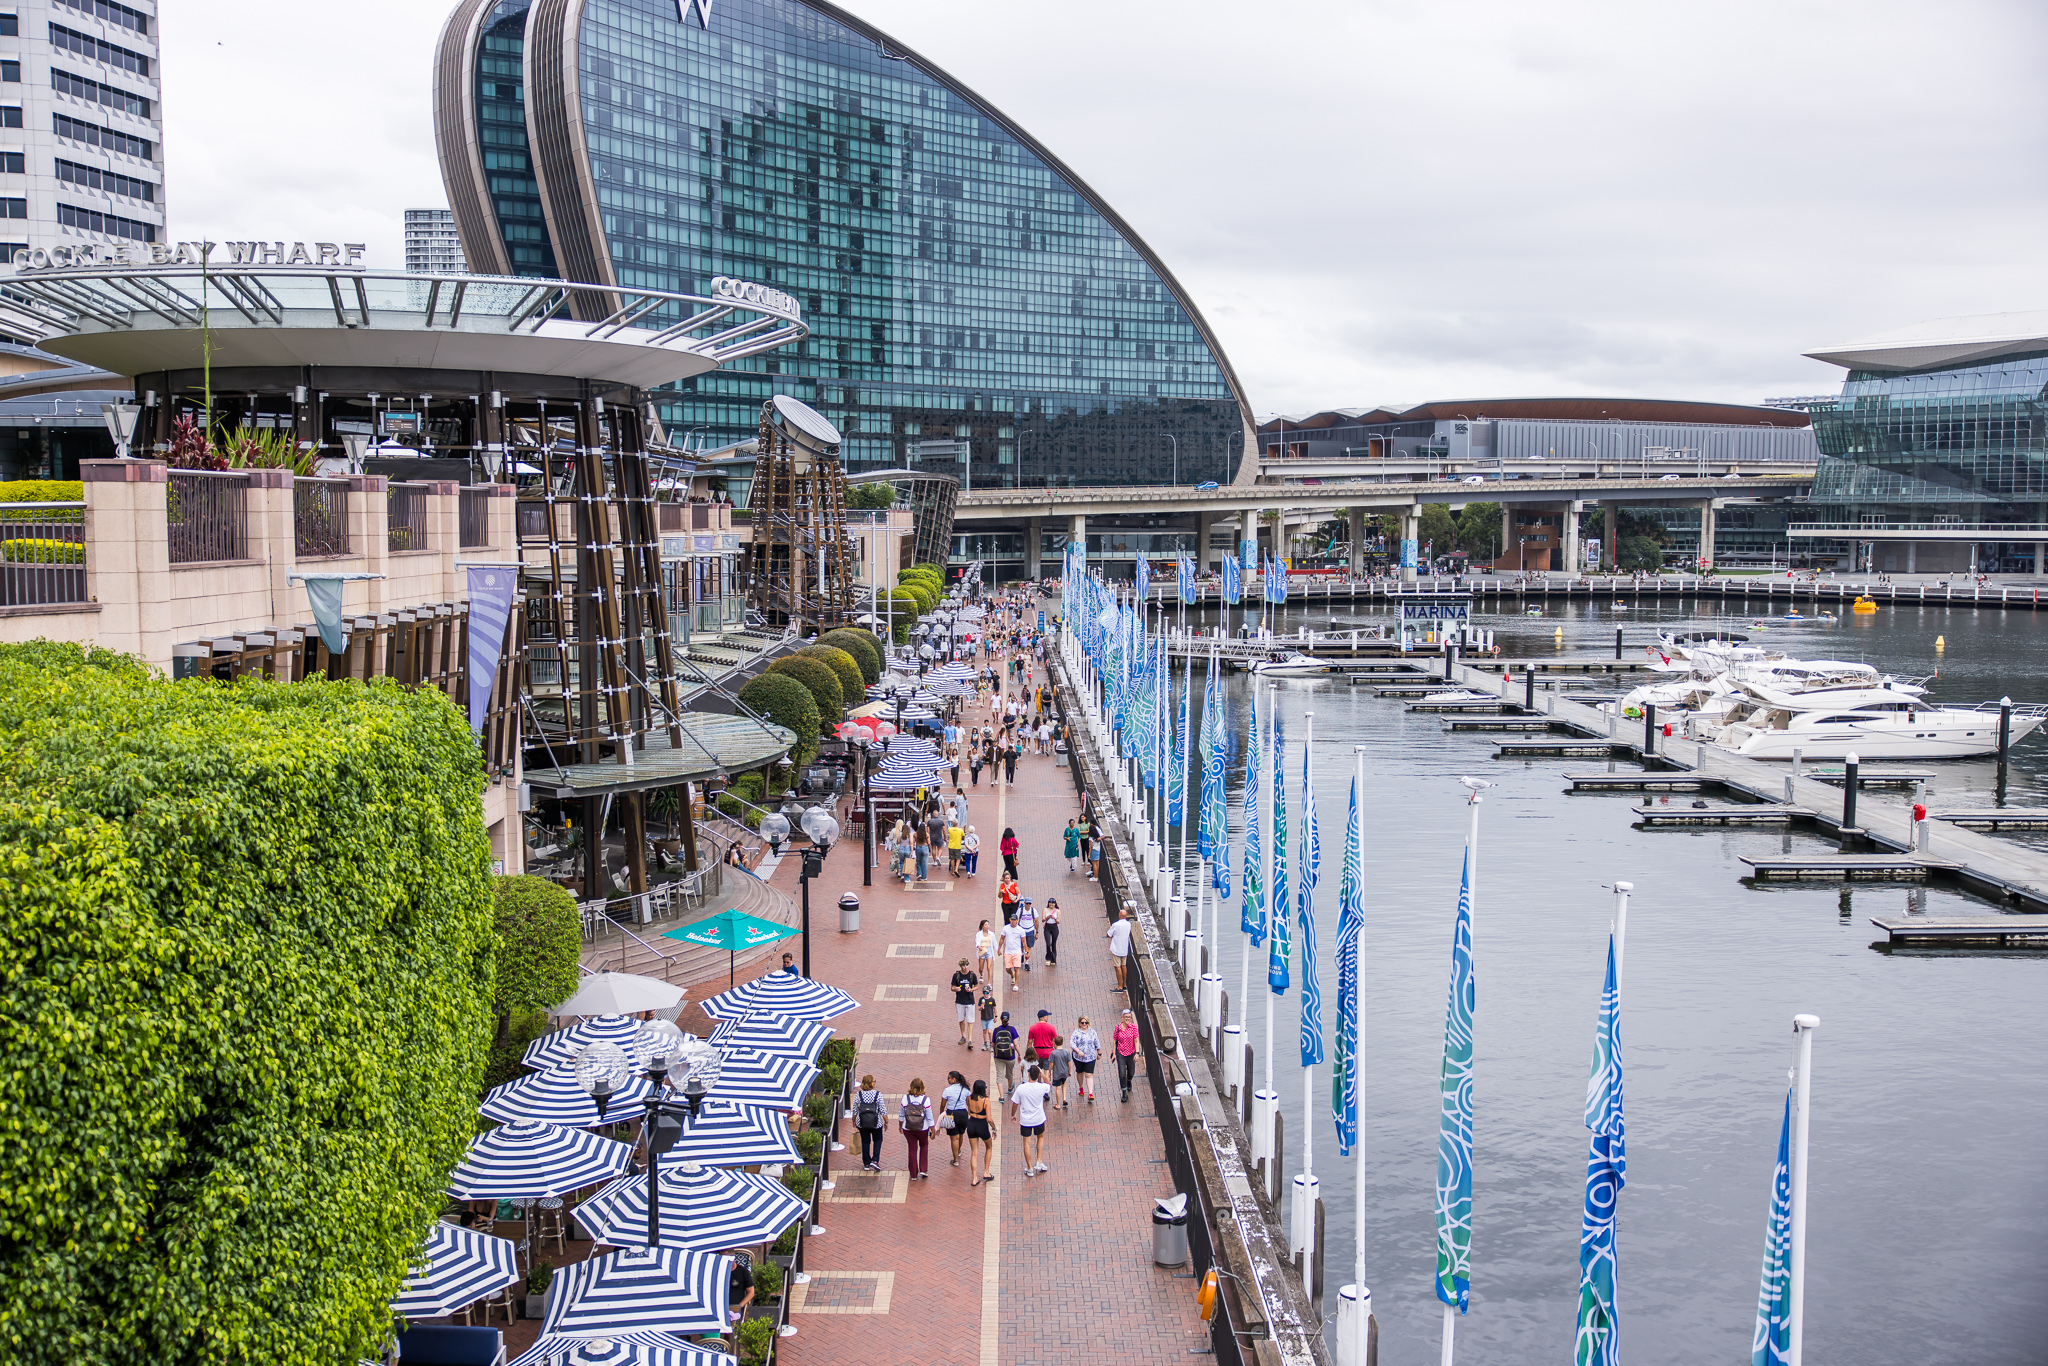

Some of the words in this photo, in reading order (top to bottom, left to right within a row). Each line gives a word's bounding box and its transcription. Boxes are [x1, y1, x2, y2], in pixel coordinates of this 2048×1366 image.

[13, 242, 131, 271] COCKLE
[147, 241, 216, 265] BAY
[225, 241, 366, 266] WHARF
[711, 276, 780, 310] COCKLE
[1405, 606, 1467, 618] MARINA
[686, 932, 724, 944] Heineken
[745, 930, 780, 943] Heineken
